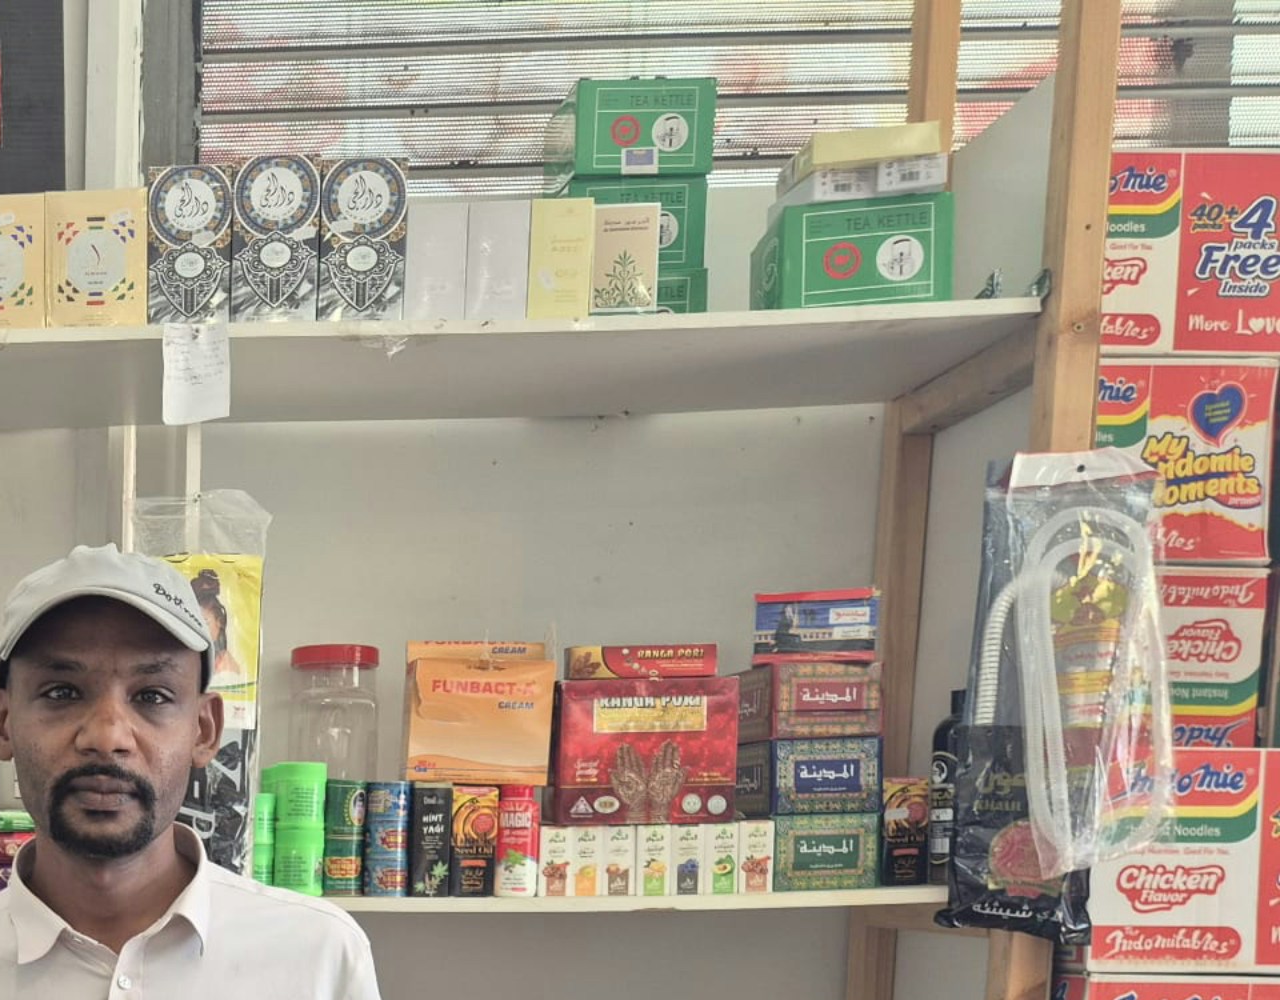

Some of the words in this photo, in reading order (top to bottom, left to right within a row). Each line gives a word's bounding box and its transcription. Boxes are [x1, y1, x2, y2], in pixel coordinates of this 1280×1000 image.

[629, 95, 649, 107] TEA
[655, 94, 694, 106] KETTLE
[846, 217, 871, 231] TEA
[878, 211, 928, 229] KETTLE
[1107, 222, 1146, 234] oodles
[1234, 239, 1276, 251] packs
[1221, 281, 1267, 295] Inside
[1101, 315, 1152, 340] tables
[1144, 434, 1187, 461] My
[1160, 446, 1254, 480] ndomie
[1170, 639, 1240, 662] Chicke
[1174, 823, 1221, 837] Noodles
[1120, 866, 1220, 892] Chicken
[1140, 888, 1188, 904] Flavor
